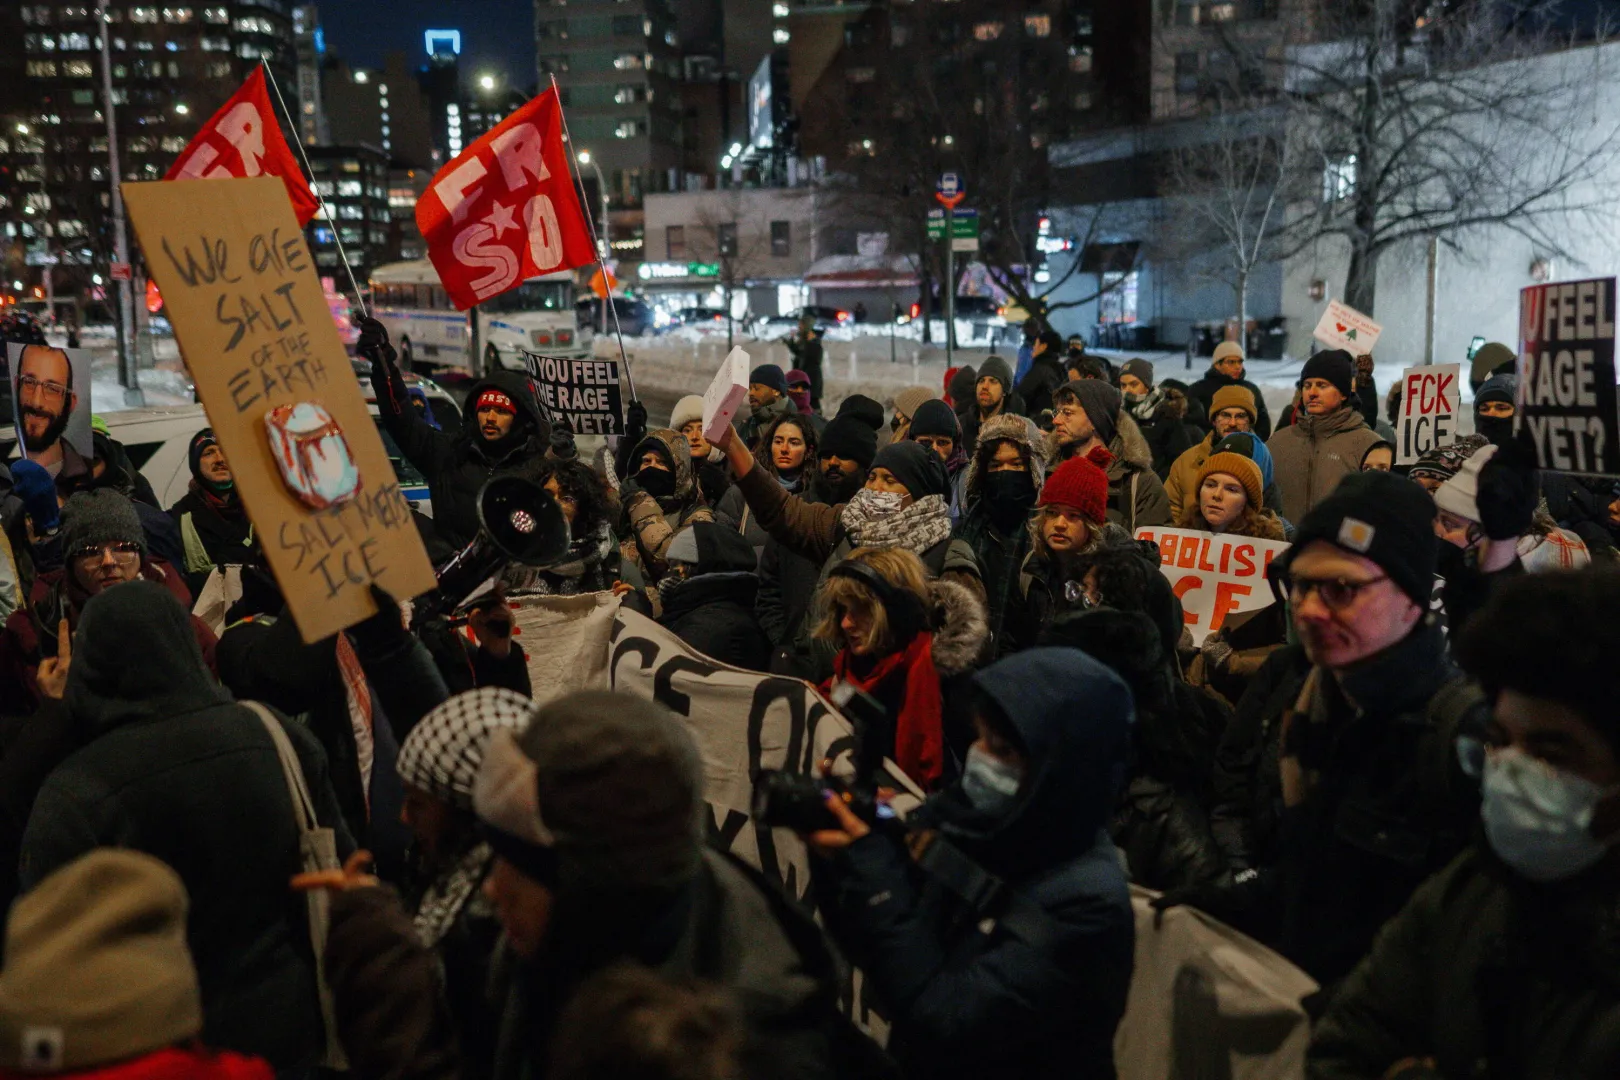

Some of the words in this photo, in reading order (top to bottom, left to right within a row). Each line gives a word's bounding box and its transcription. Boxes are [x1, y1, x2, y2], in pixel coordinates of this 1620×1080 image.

[161, 236, 241, 287] We
[216, 281, 304, 353] SALT
[1543, 281, 1615, 342] FEEL
[252, 343, 273, 367] OF
[276, 332, 311, 360] THE
[536, 356, 569, 384] YOU
[571, 361, 619, 385] FEEL
[227, 359, 328, 413] EARTH
[532, 379, 555, 408] THE
[557, 386, 610, 411] RAGE
[1405, 373, 1454, 417] FCK
[1521, 349, 1597, 408] RAGE
[566, 413, 616, 434] YET?
[1403, 414, 1452, 458] ICE
[1526, 415, 1607, 474] YET?
[279, 501, 356, 571] SALT
[309, 537, 388, 599] ICE
[1172, 575, 1253, 631] CE
